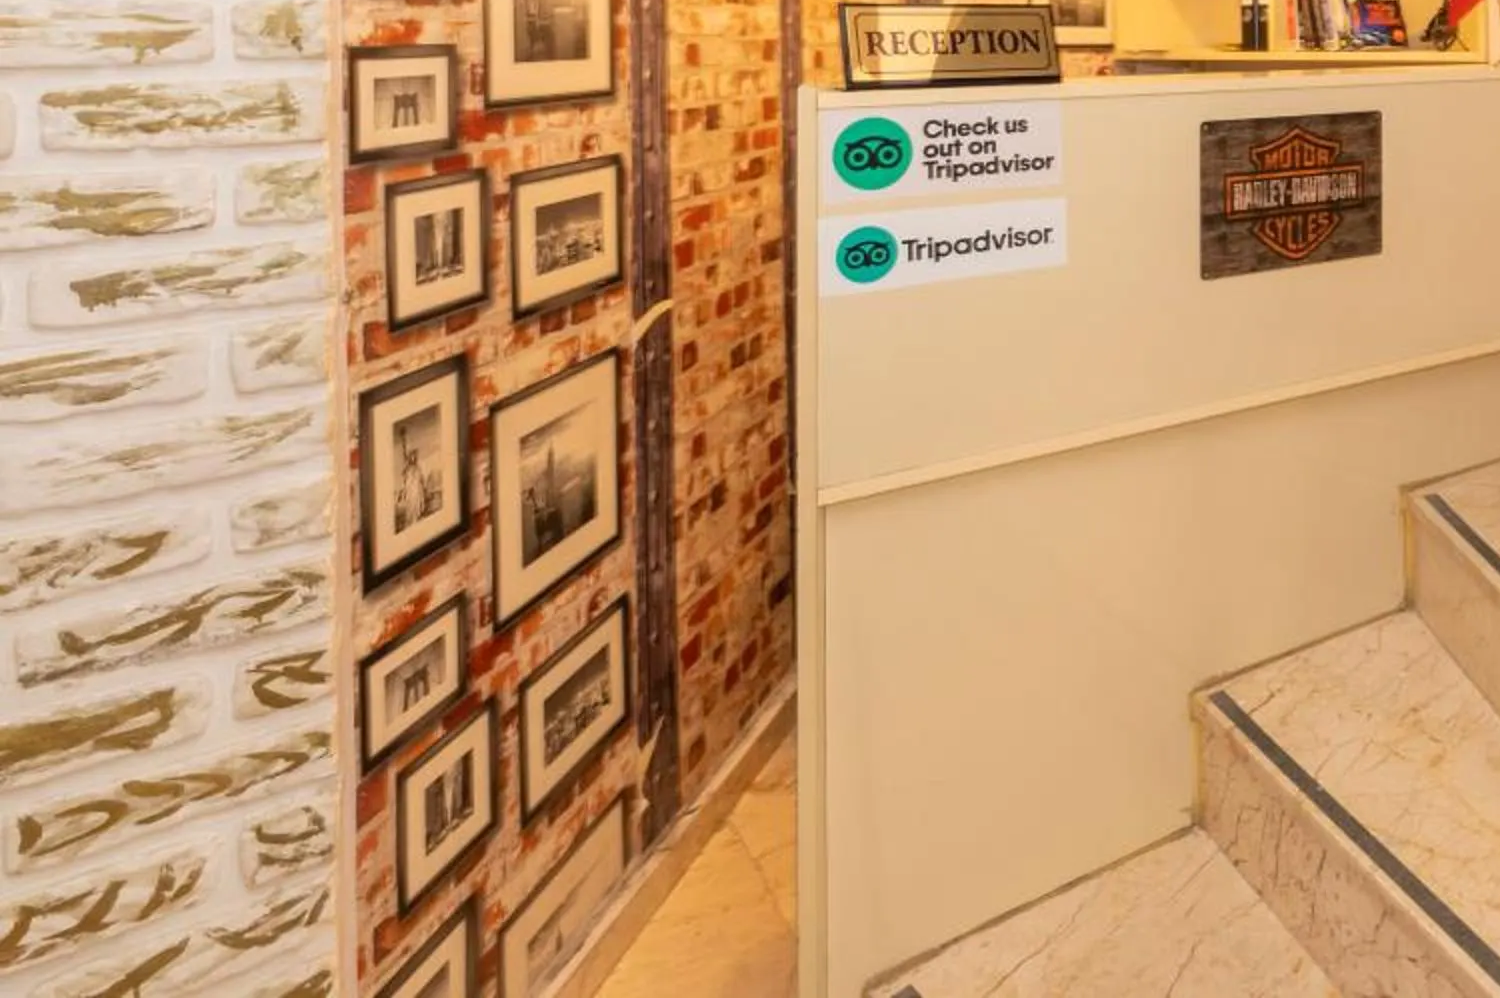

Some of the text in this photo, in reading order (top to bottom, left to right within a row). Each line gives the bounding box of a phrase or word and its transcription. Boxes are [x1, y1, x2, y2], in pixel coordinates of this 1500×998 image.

[864, 29, 1042, 57] RECEPTION
[923, 116, 1029, 139] Check us
[923, 138, 997, 159] out on
[1264, 140, 1330, 168] MOTOR
[922, 154, 1055, 182] Tripadvisor
[901, 227, 1054, 263] Tripadvisor
[1264, 212, 1330, 250] CYCLES
